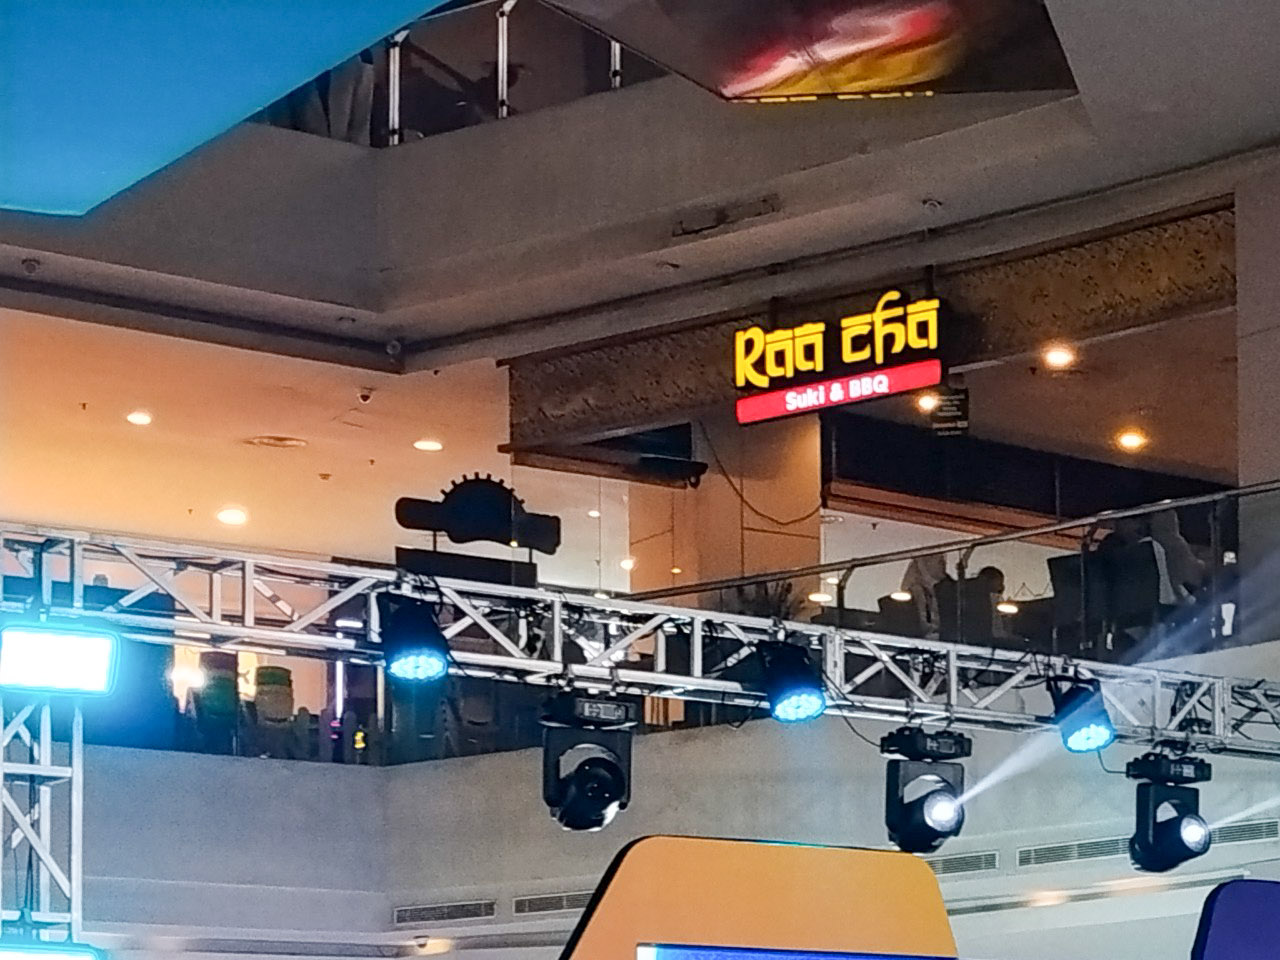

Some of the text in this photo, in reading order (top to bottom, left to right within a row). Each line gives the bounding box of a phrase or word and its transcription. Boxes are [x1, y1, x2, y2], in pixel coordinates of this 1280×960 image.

[785, 374, 889, 411] Suki & BBQ
